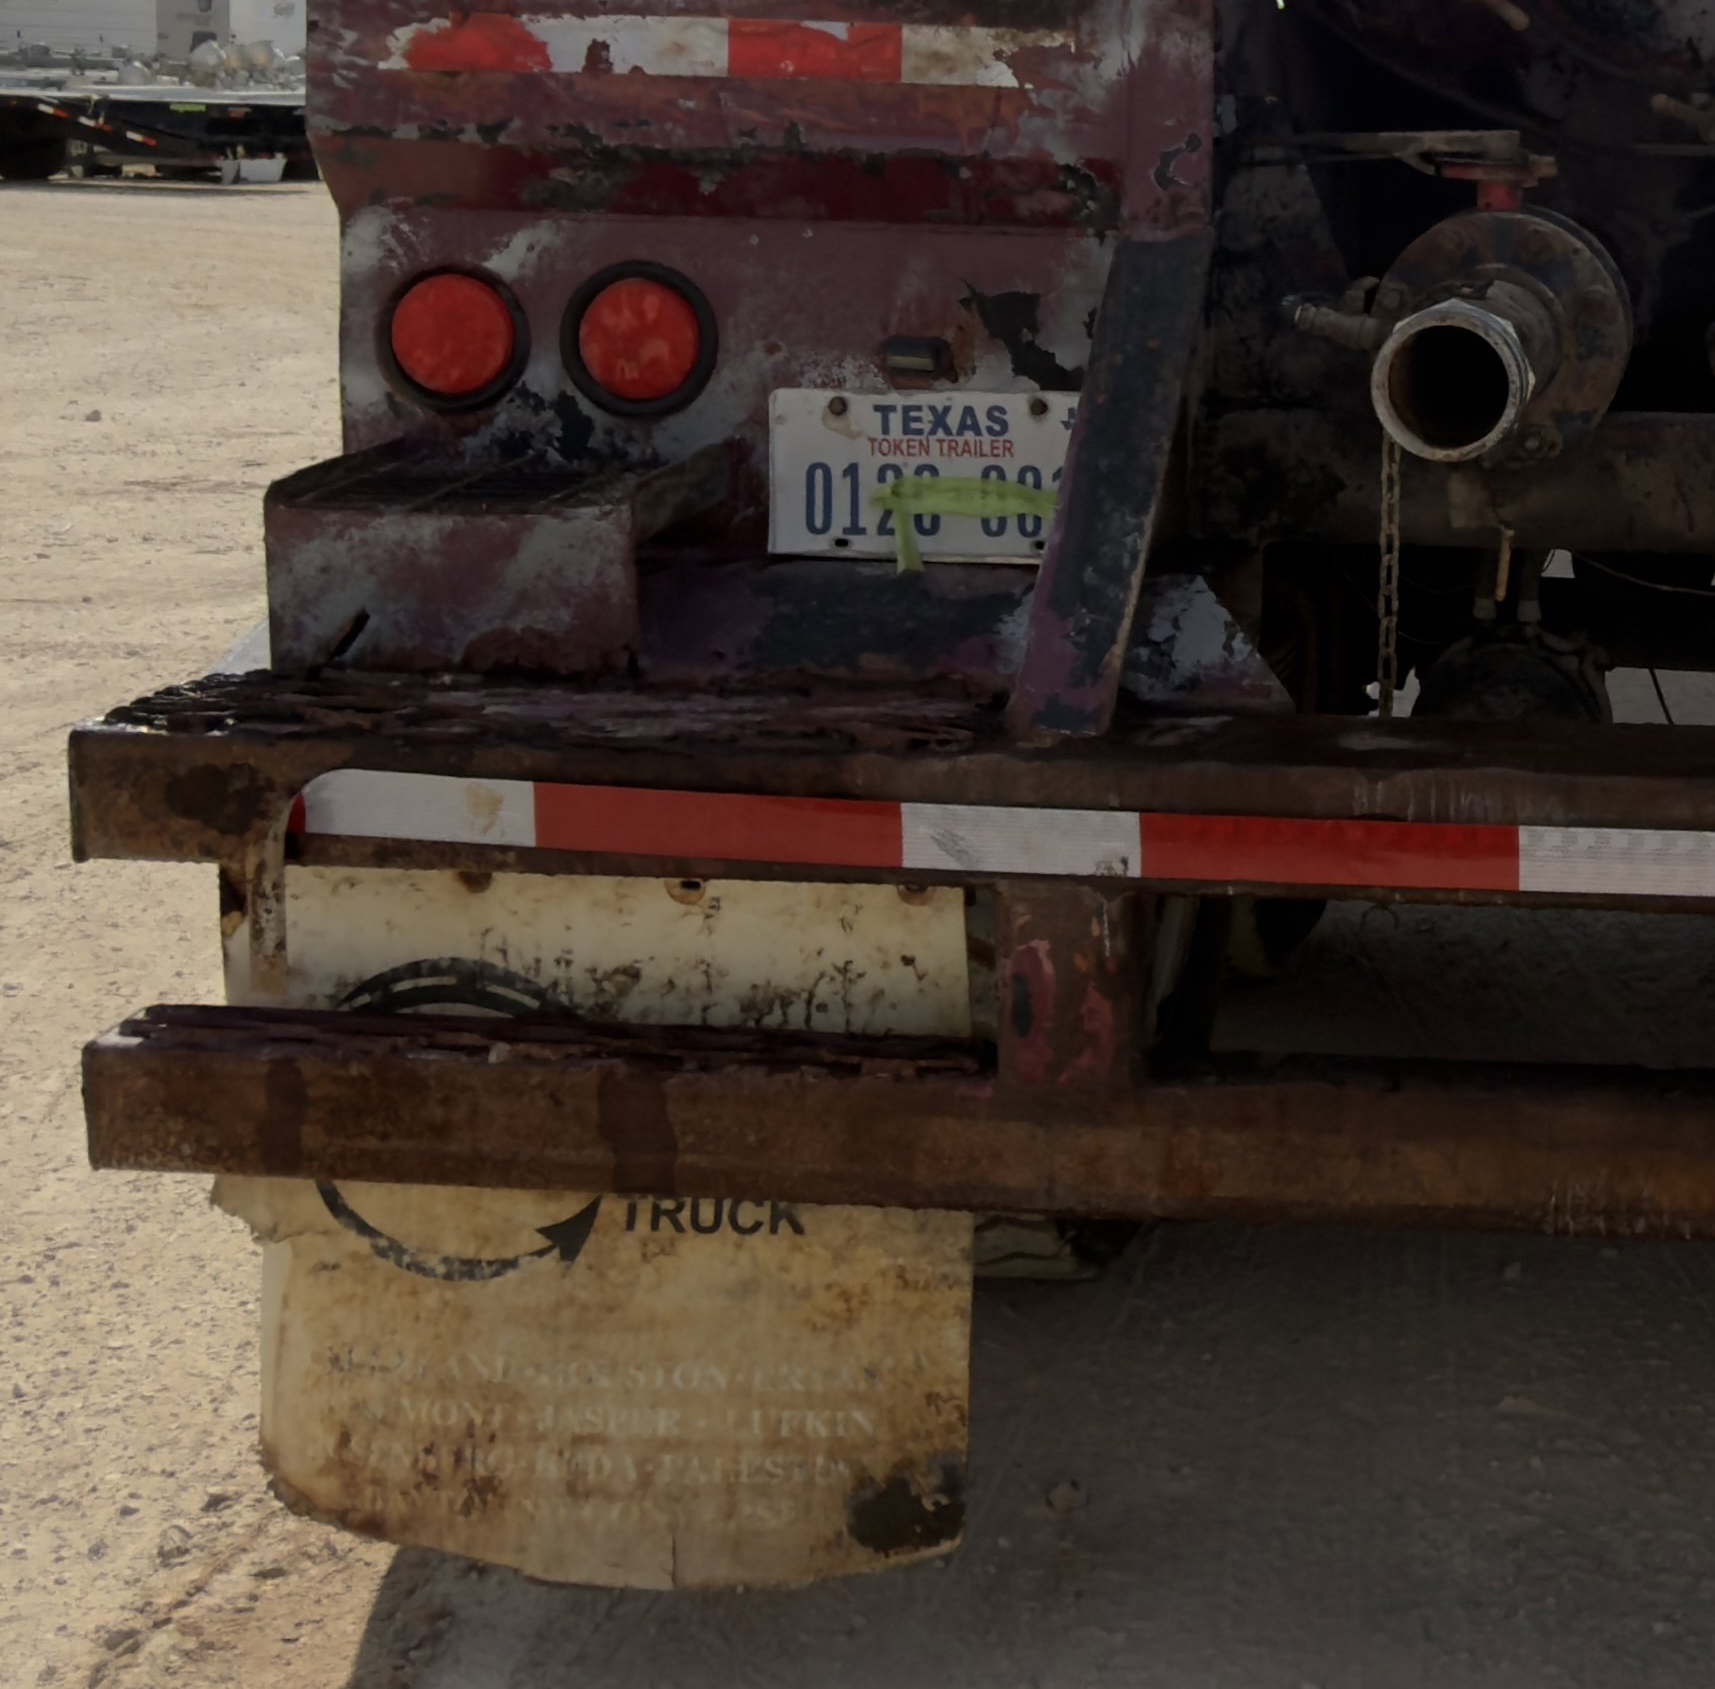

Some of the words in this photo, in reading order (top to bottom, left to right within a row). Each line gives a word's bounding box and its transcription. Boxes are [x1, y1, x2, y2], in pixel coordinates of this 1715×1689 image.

[873, 404, 1009, 438] TEXAS
[867, 437, 931, 458] TOKEN
[936, 438, 1014, 459] TRAILER
[624, 1197, 805, 1236] TRUCK
